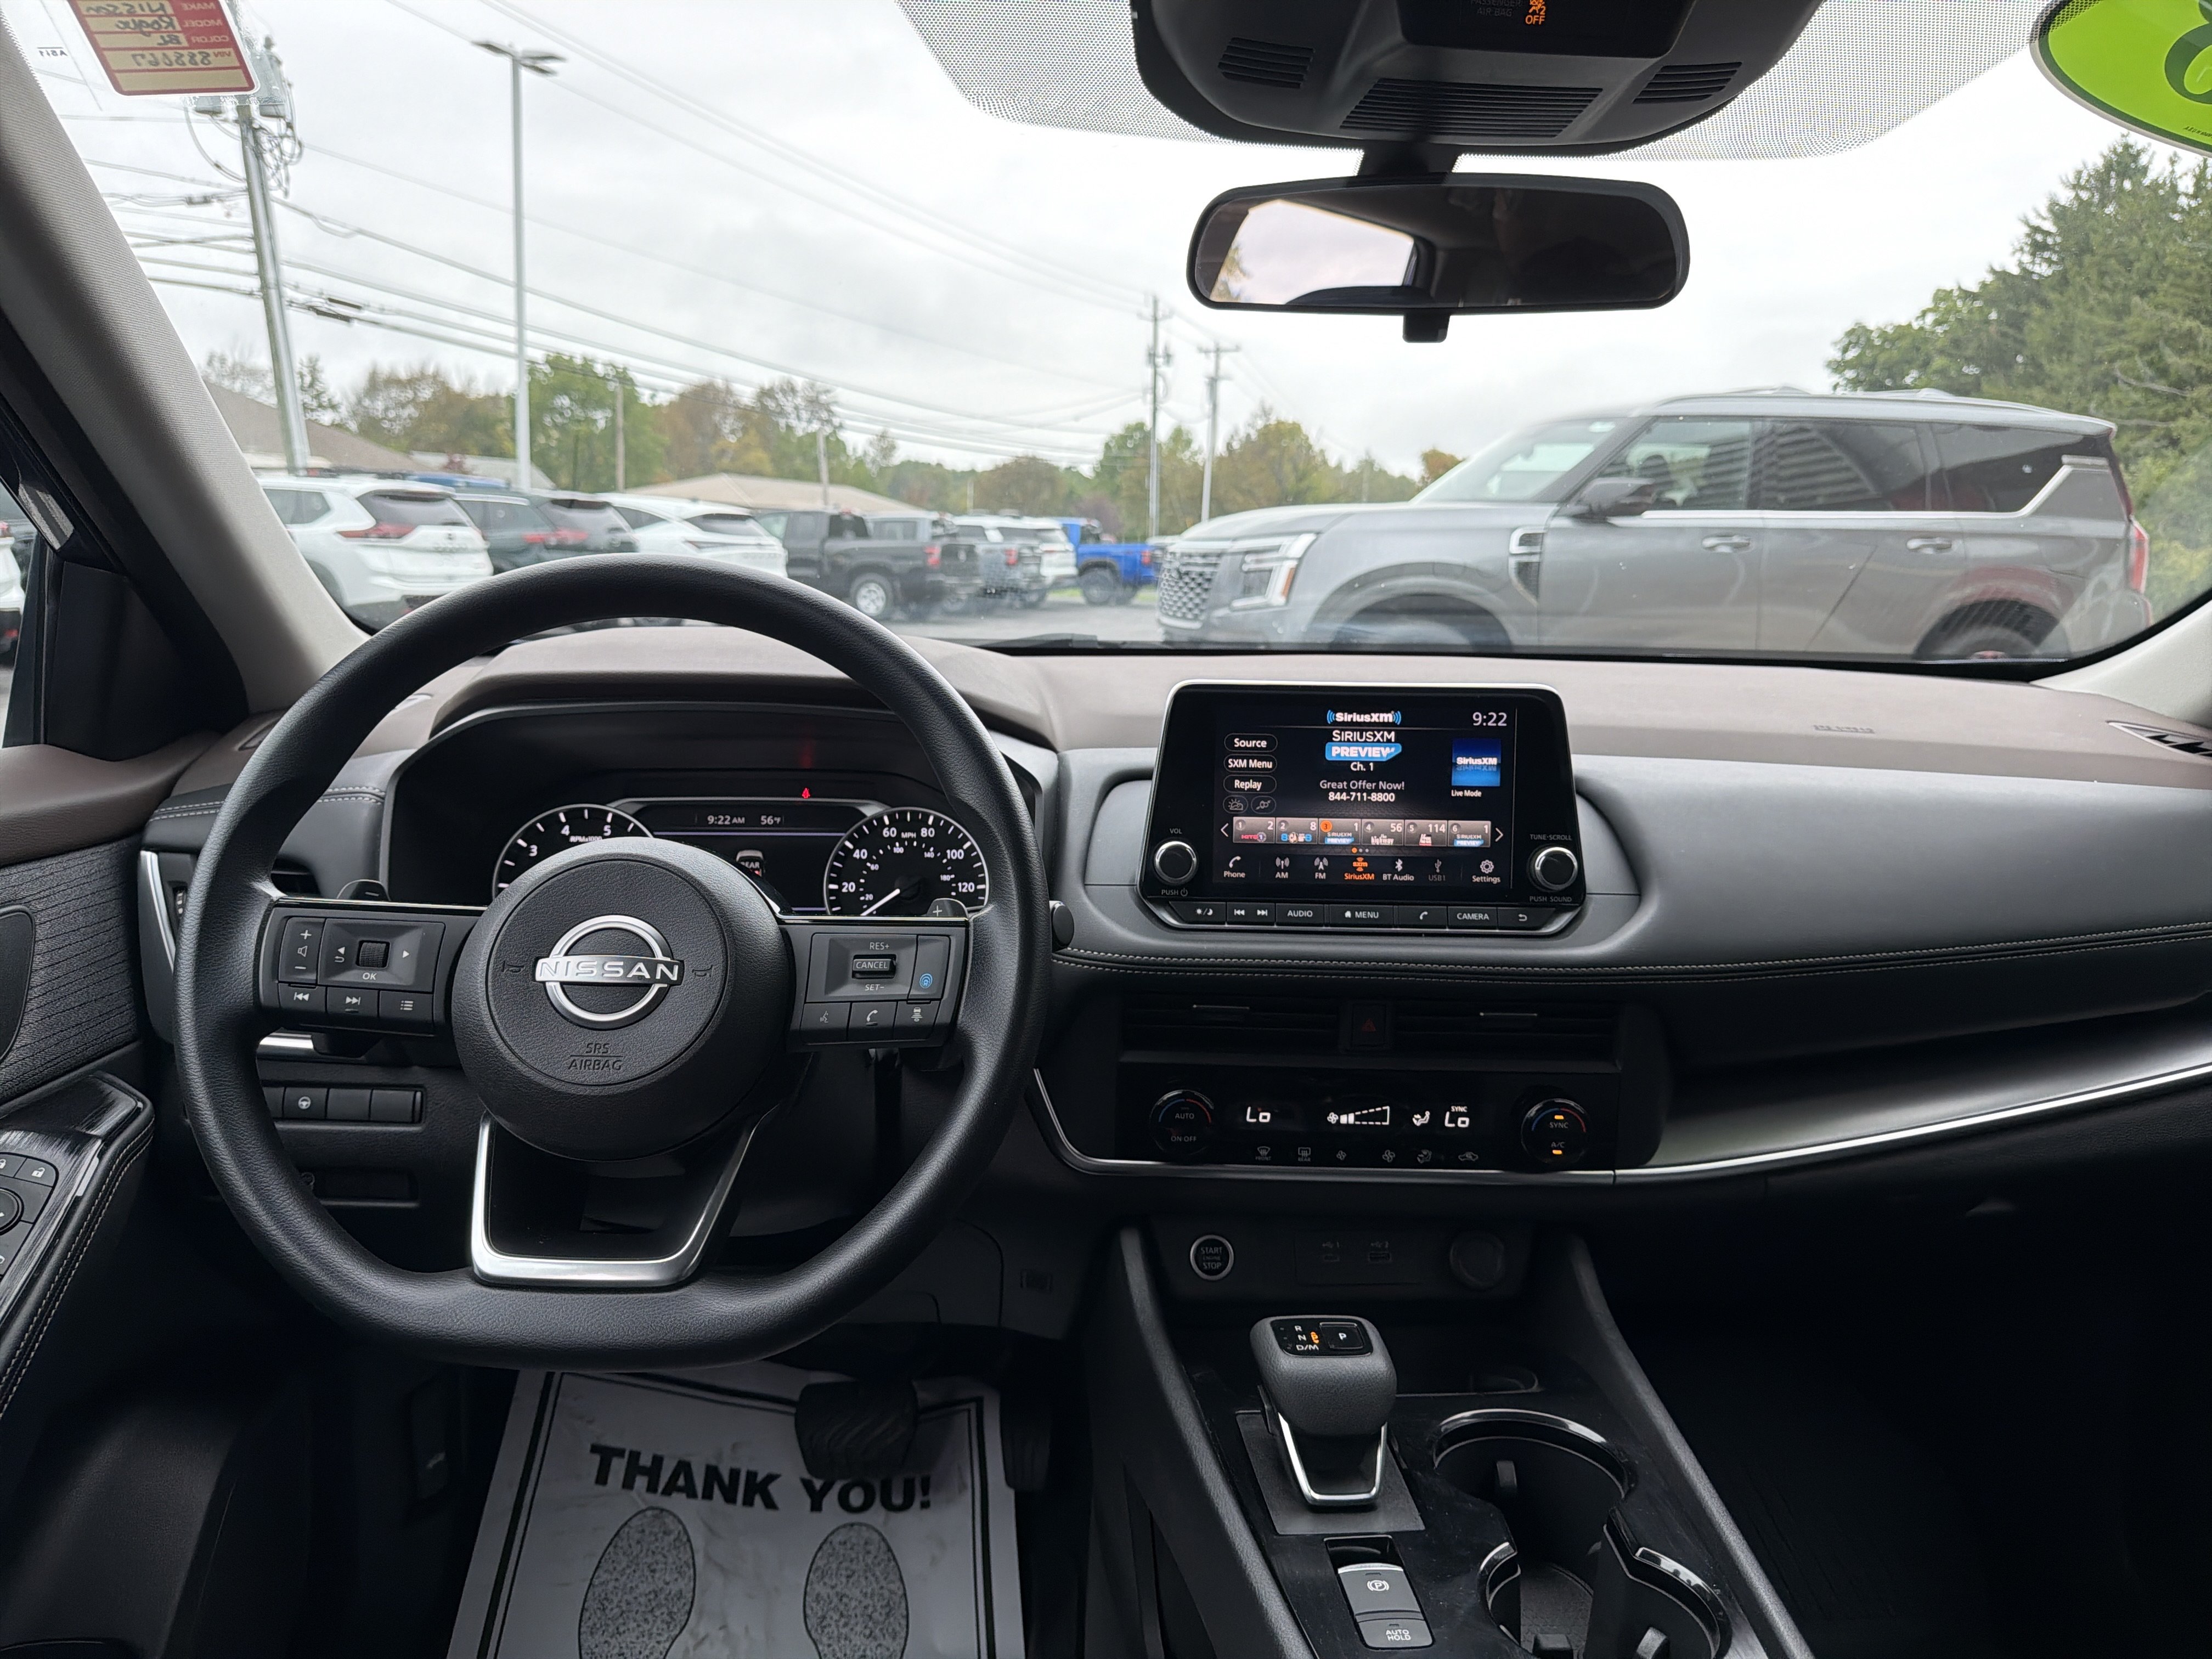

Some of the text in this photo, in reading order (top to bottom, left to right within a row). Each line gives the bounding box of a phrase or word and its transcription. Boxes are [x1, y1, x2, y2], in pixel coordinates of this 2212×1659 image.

[1477, 7, 1513, 17] AIR BAG
[1525, 15, 1545, 25] OFF
[1472, 712, 1508, 726] 9:22
[1332, 730, 1395, 742] SIRIUSXM
[1234, 738, 1267, 748] Source
[1331, 746, 1395, 757] PREVIEW
[1228, 758, 1273, 769] SXM Menu
[1350, 761, 1374, 771] Ch. 1
[1234, 779, 1262, 791] Replay
[1319, 780, 1404, 791] Great Offer Now!
[1328, 792, 1395, 802] 844-711-8800
[707, 815, 731, 825] 9:22
[1267, 821, 1273, 830] 2
[561, 825, 570, 836] 4
[603, 825, 612, 836] 5
[1310, 821, 1316, 831] 8
[1353, 822, 1358, 831] 1
[1390, 823, 1402, 832] 56
[1428, 823, 1446, 833] 114
[1483, 825, 1488, 834] 1
[883, 827, 897, 838] 60
[921, 827, 935, 838] 80
[528, 845, 538, 857] 3
[853, 849, 868, 860] 40
[946, 849, 964, 860] 100
[1472, 875, 1502, 884] Settings
[842, 882, 856, 893] 20
[957, 882, 975, 893] 120
[1457, 913, 1489, 921] CAMERA
[855, 961, 888, 969] CANCEL
[362, 972, 377, 981] OK
[539, 961, 679, 981] NISSAN
[585, 1043, 610, 1054] SRS
[568, 1058, 623, 1071] AIRBAG
[1246, 1106, 1271, 1123] Lo
[1200, 1246, 1223, 1255] START
[1203, 1262, 1222, 1270] STOP
[590, 1443, 932, 1514] THANK YOU!
